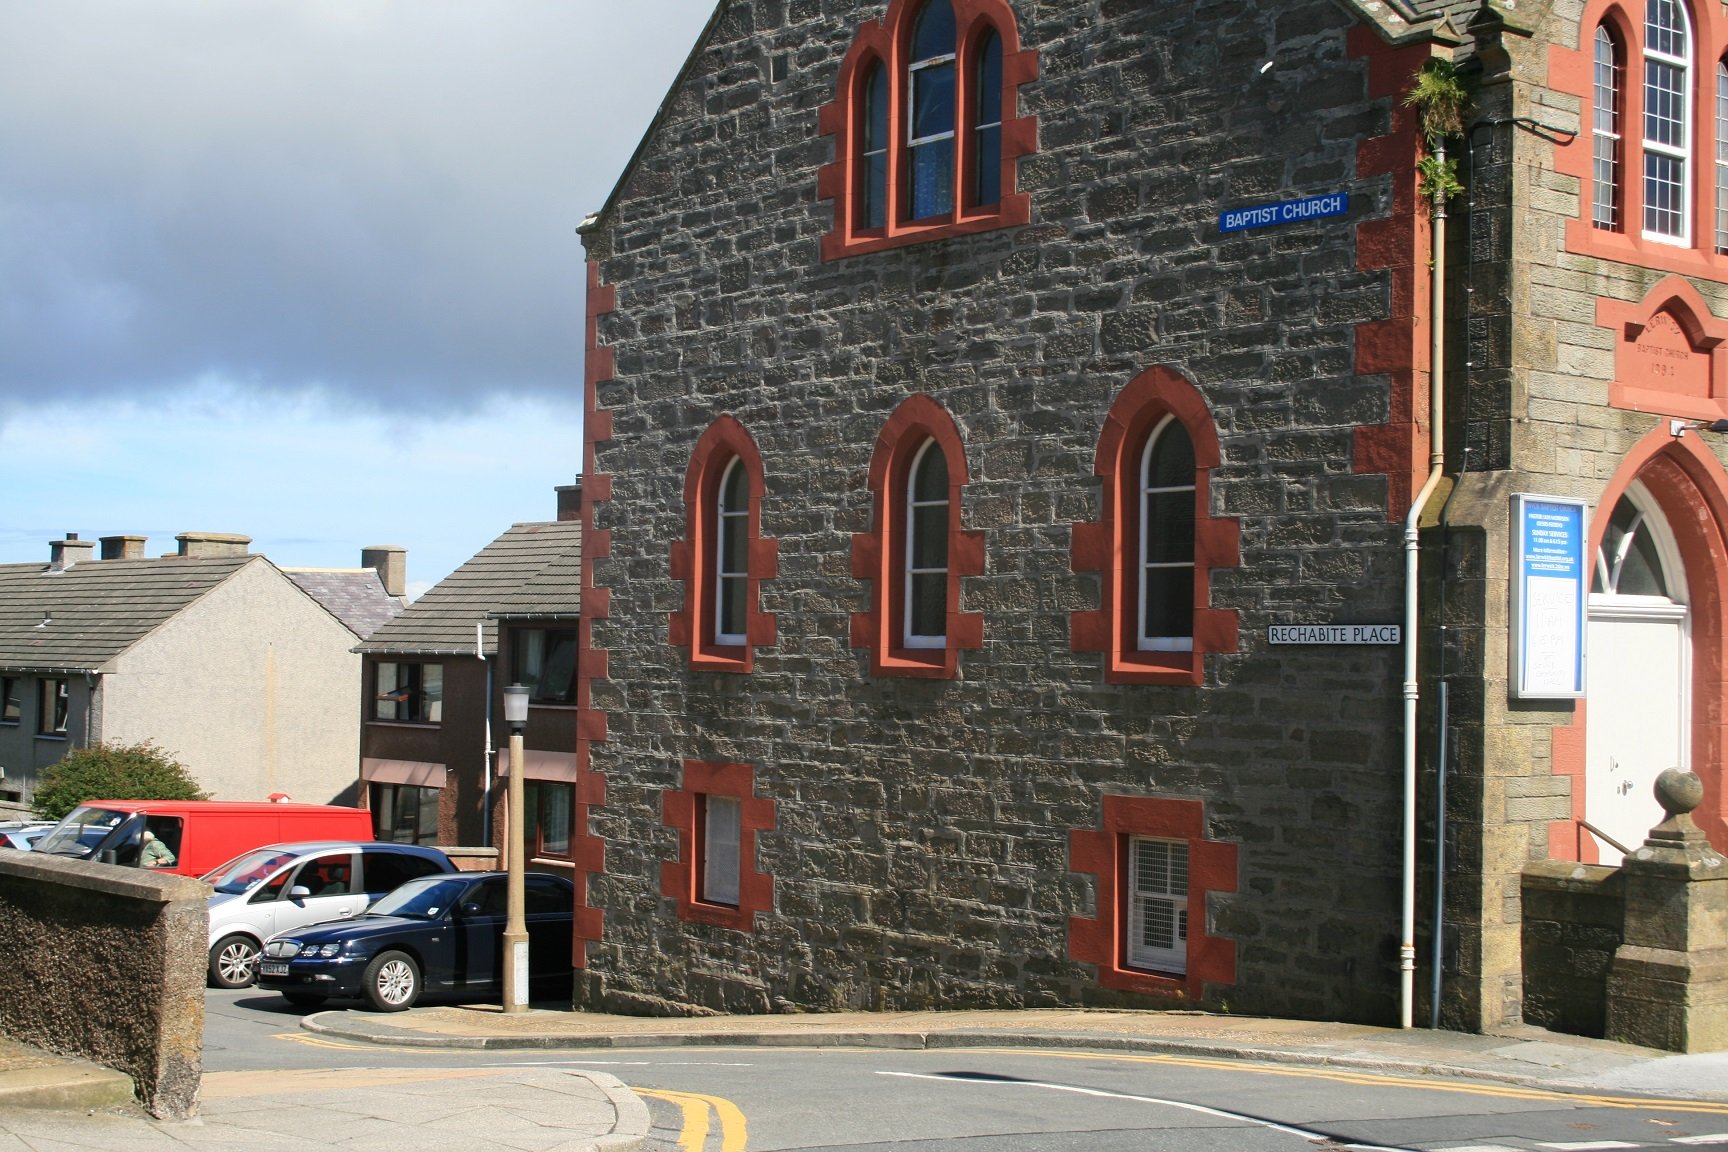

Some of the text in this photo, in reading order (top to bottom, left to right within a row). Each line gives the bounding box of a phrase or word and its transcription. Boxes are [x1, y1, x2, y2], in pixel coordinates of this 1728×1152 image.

[1226, 197, 1340, 228] BAPTIST CHURCH
[1531, 529, 1568, 538] SUNDAY SERVICES
[1271, 626, 1397, 642] RECHABITE PLACE
